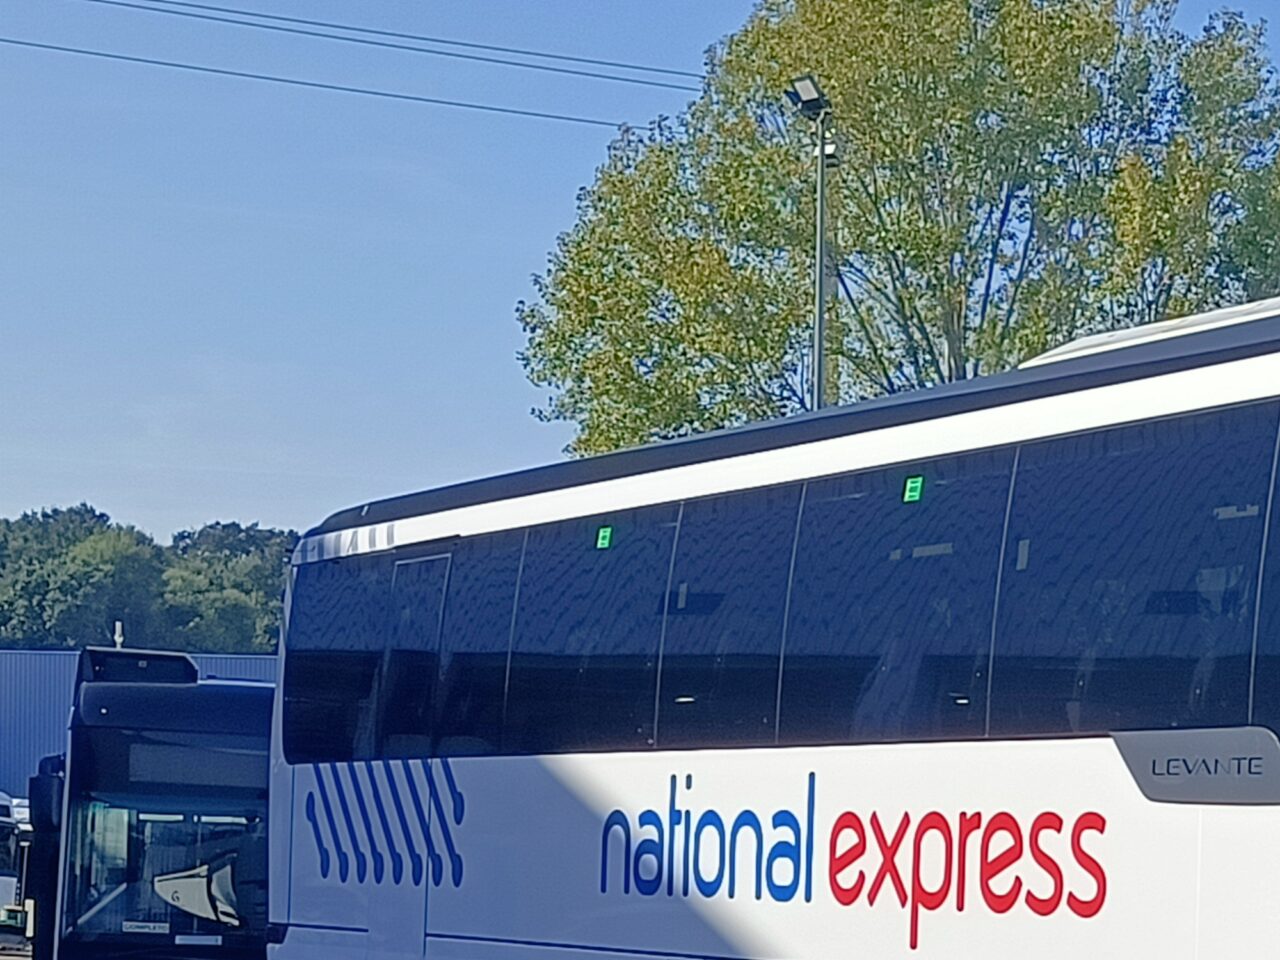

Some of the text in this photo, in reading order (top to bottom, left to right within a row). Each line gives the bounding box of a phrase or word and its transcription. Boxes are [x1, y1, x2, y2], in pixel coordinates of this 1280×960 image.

[1152, 756, 1264, 776] LEVANTE
[601, 773, 1107, 949] national express
